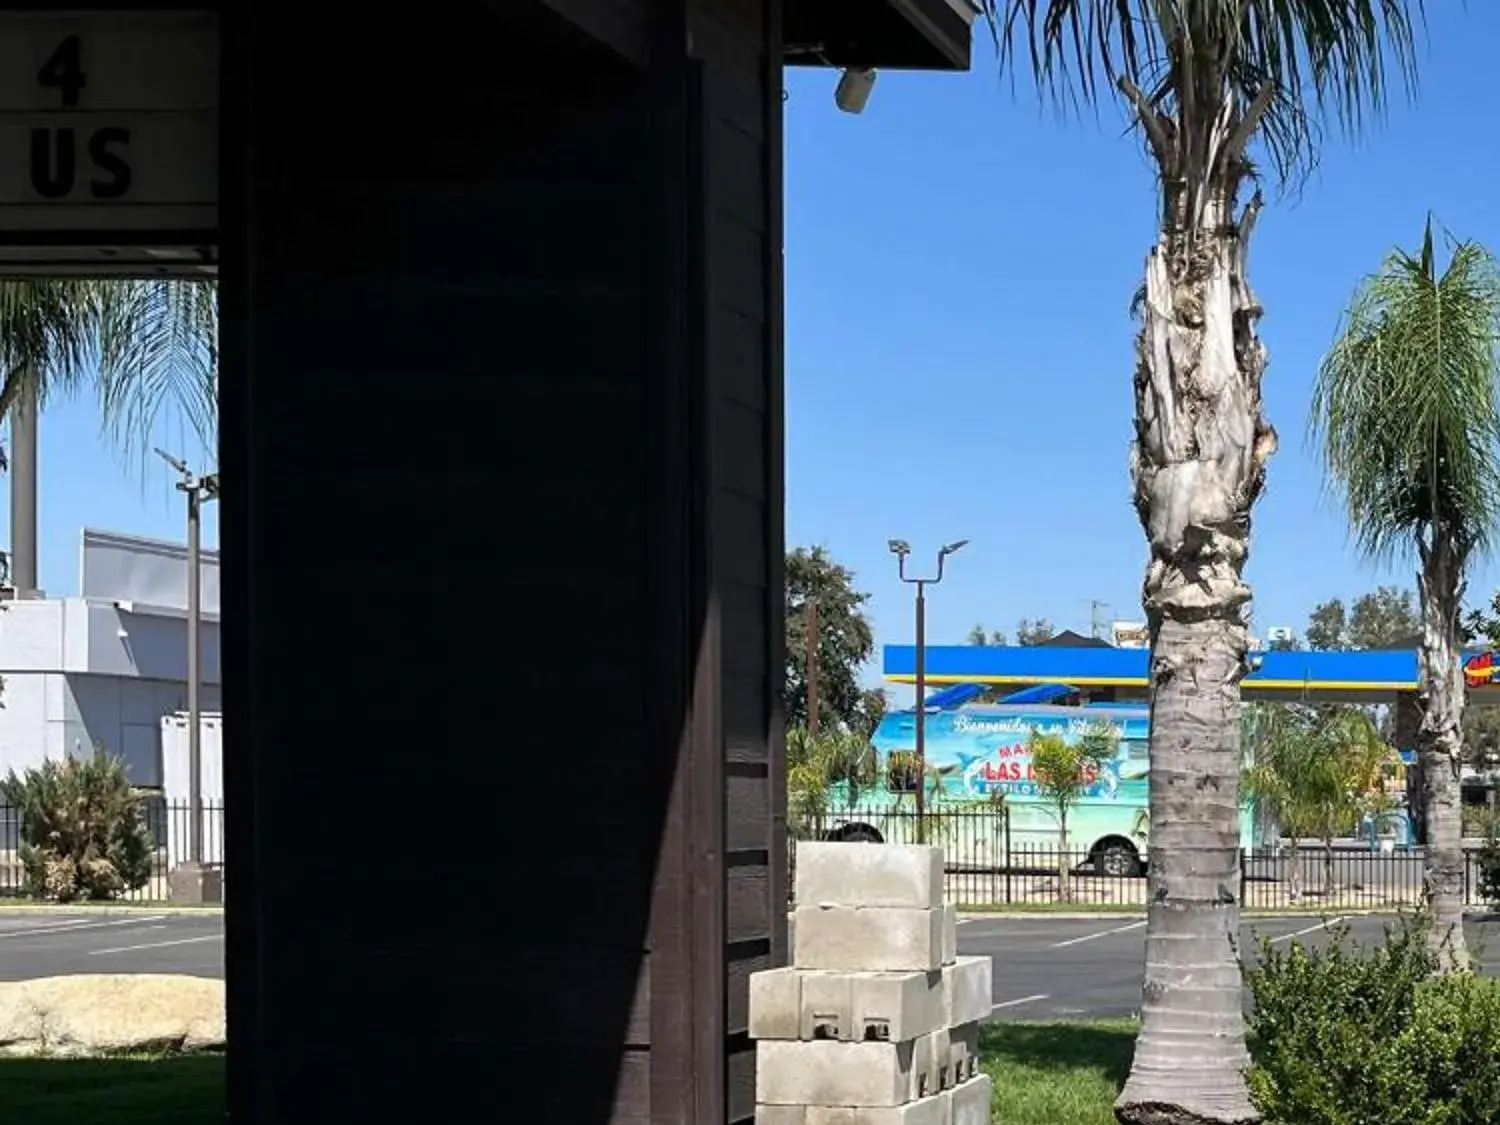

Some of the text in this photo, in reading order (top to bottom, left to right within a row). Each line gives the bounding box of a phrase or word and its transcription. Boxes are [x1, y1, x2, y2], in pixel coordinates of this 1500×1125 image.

[37, 35, 88, 107] 4
[31, 127, 131, 199] US
[985, 762, 1021, 781] LAS
